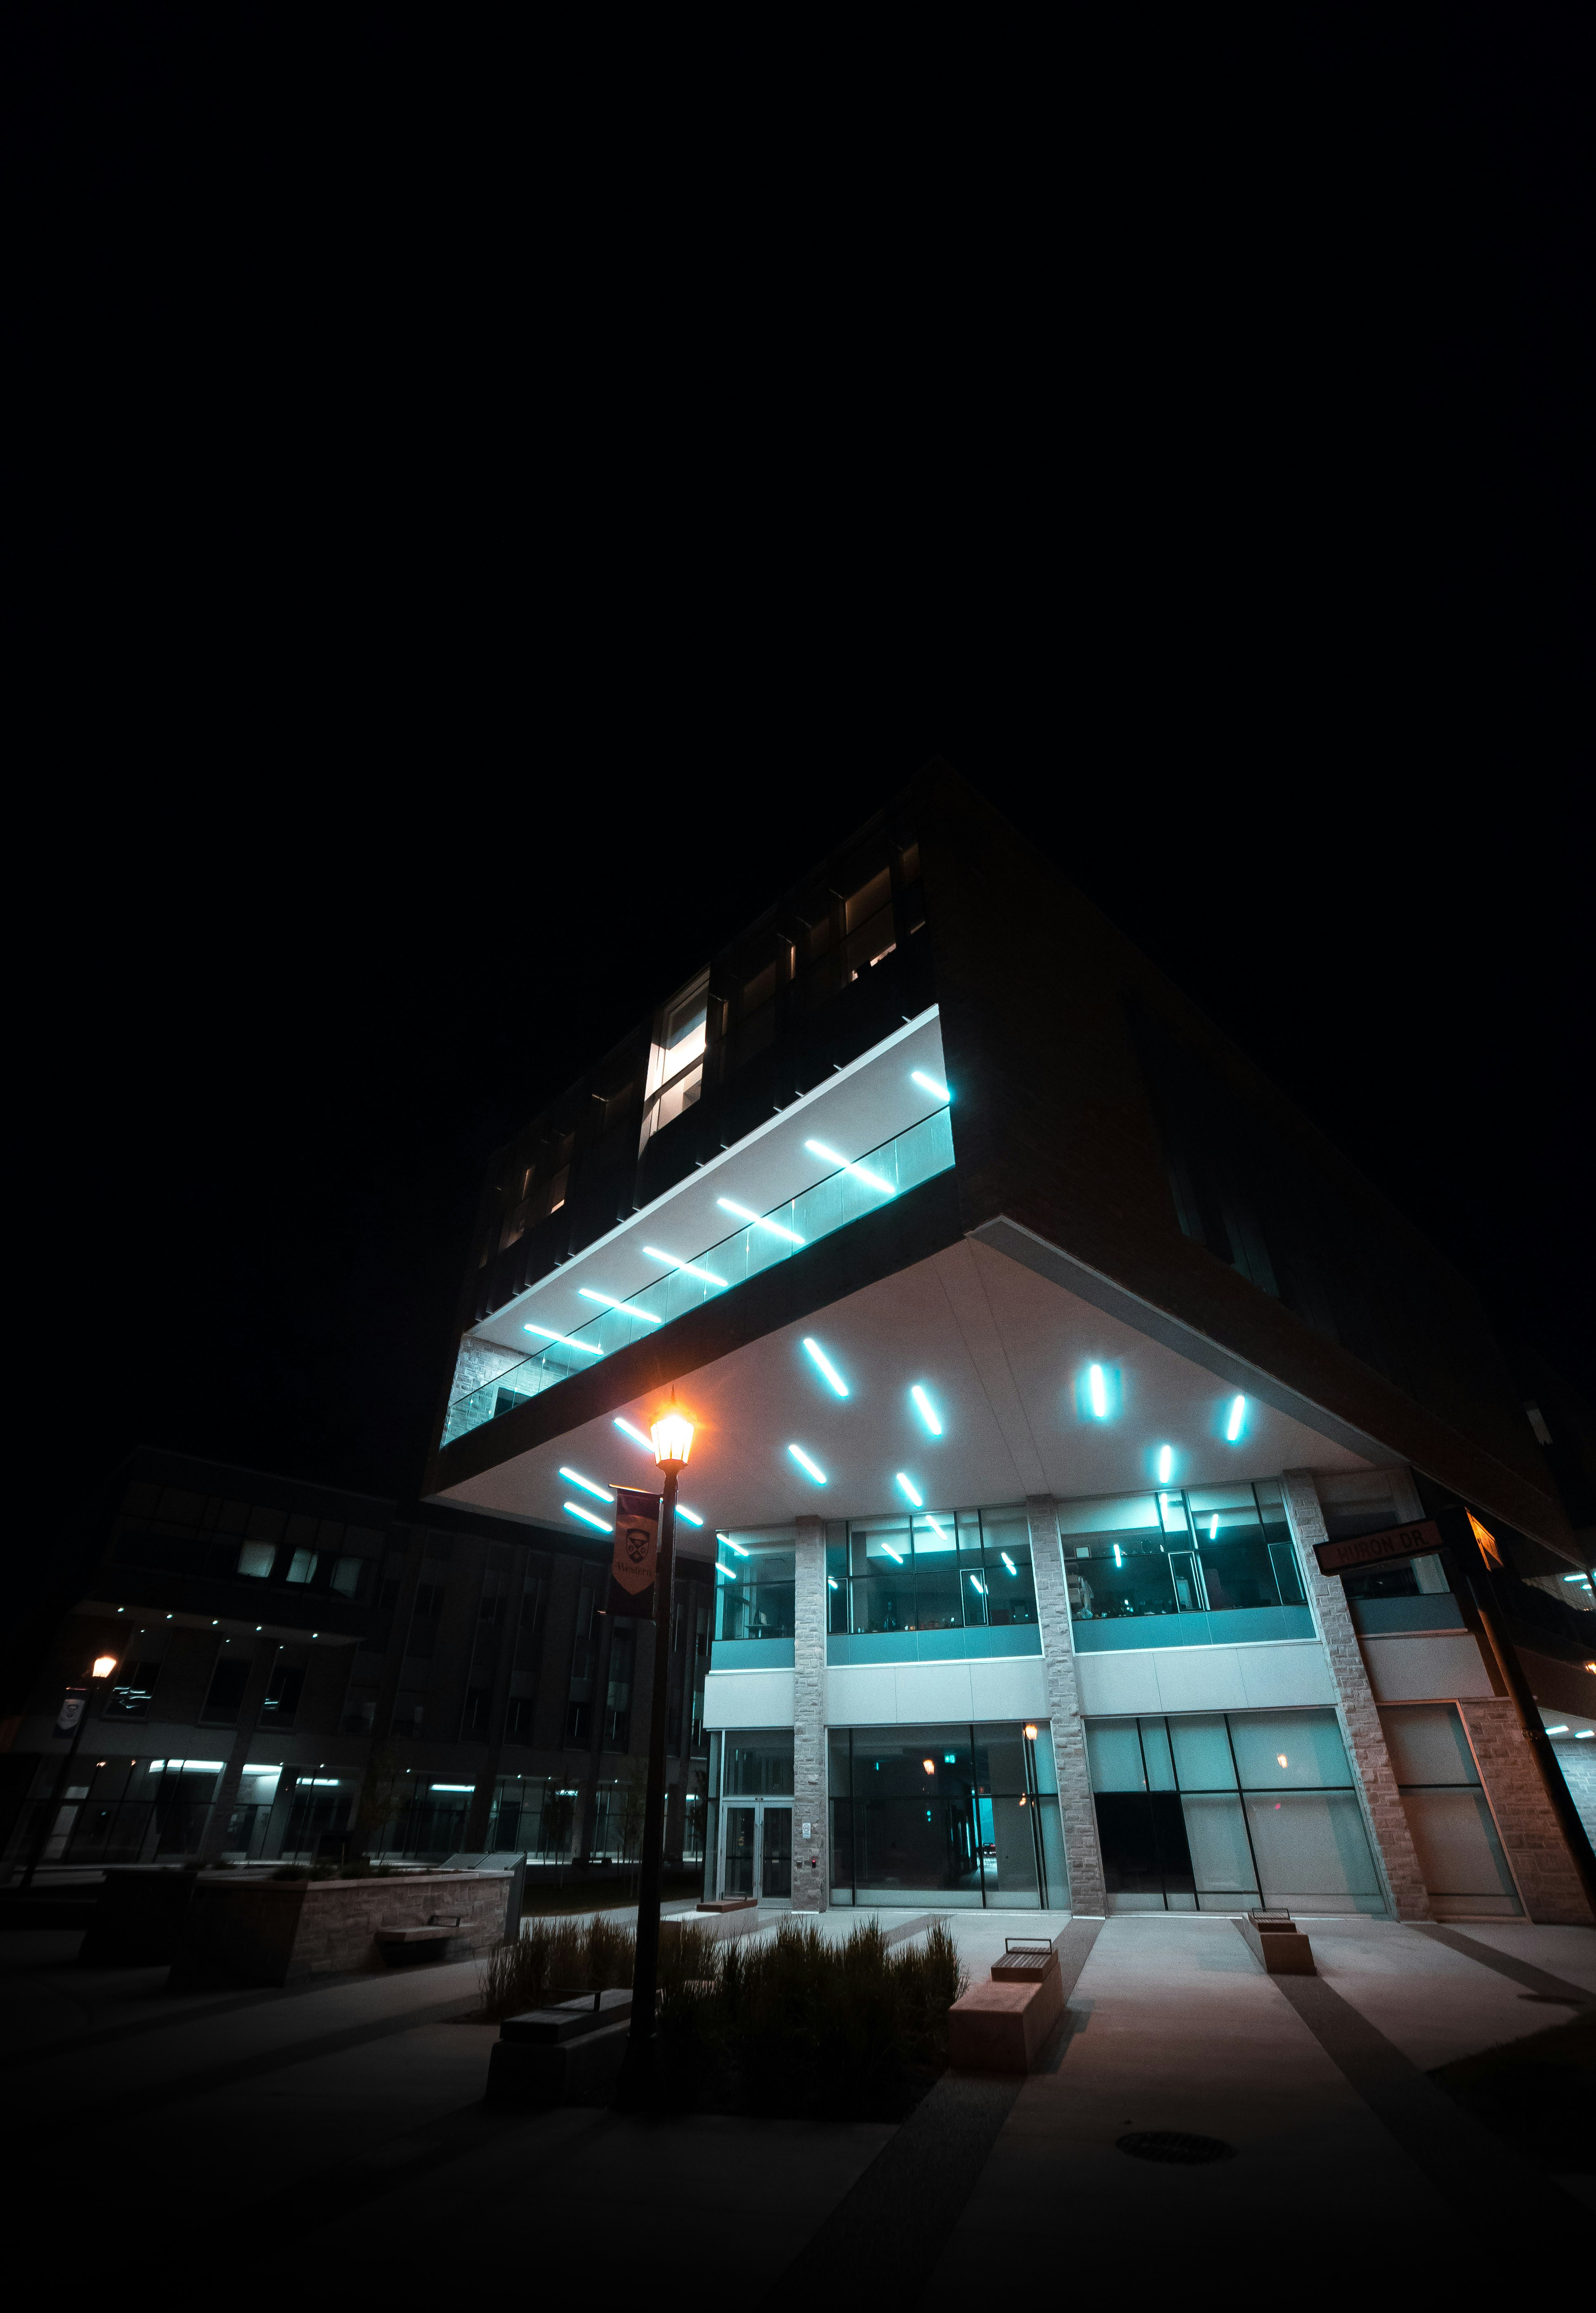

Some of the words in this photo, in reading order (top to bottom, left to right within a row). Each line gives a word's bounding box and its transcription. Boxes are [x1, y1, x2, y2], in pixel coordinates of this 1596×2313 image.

[1337, 1536, 1395, 1563] HURON
[1399, 1529, 1429, 1549] DR.
[617, 1562, 653, 1577] Western
